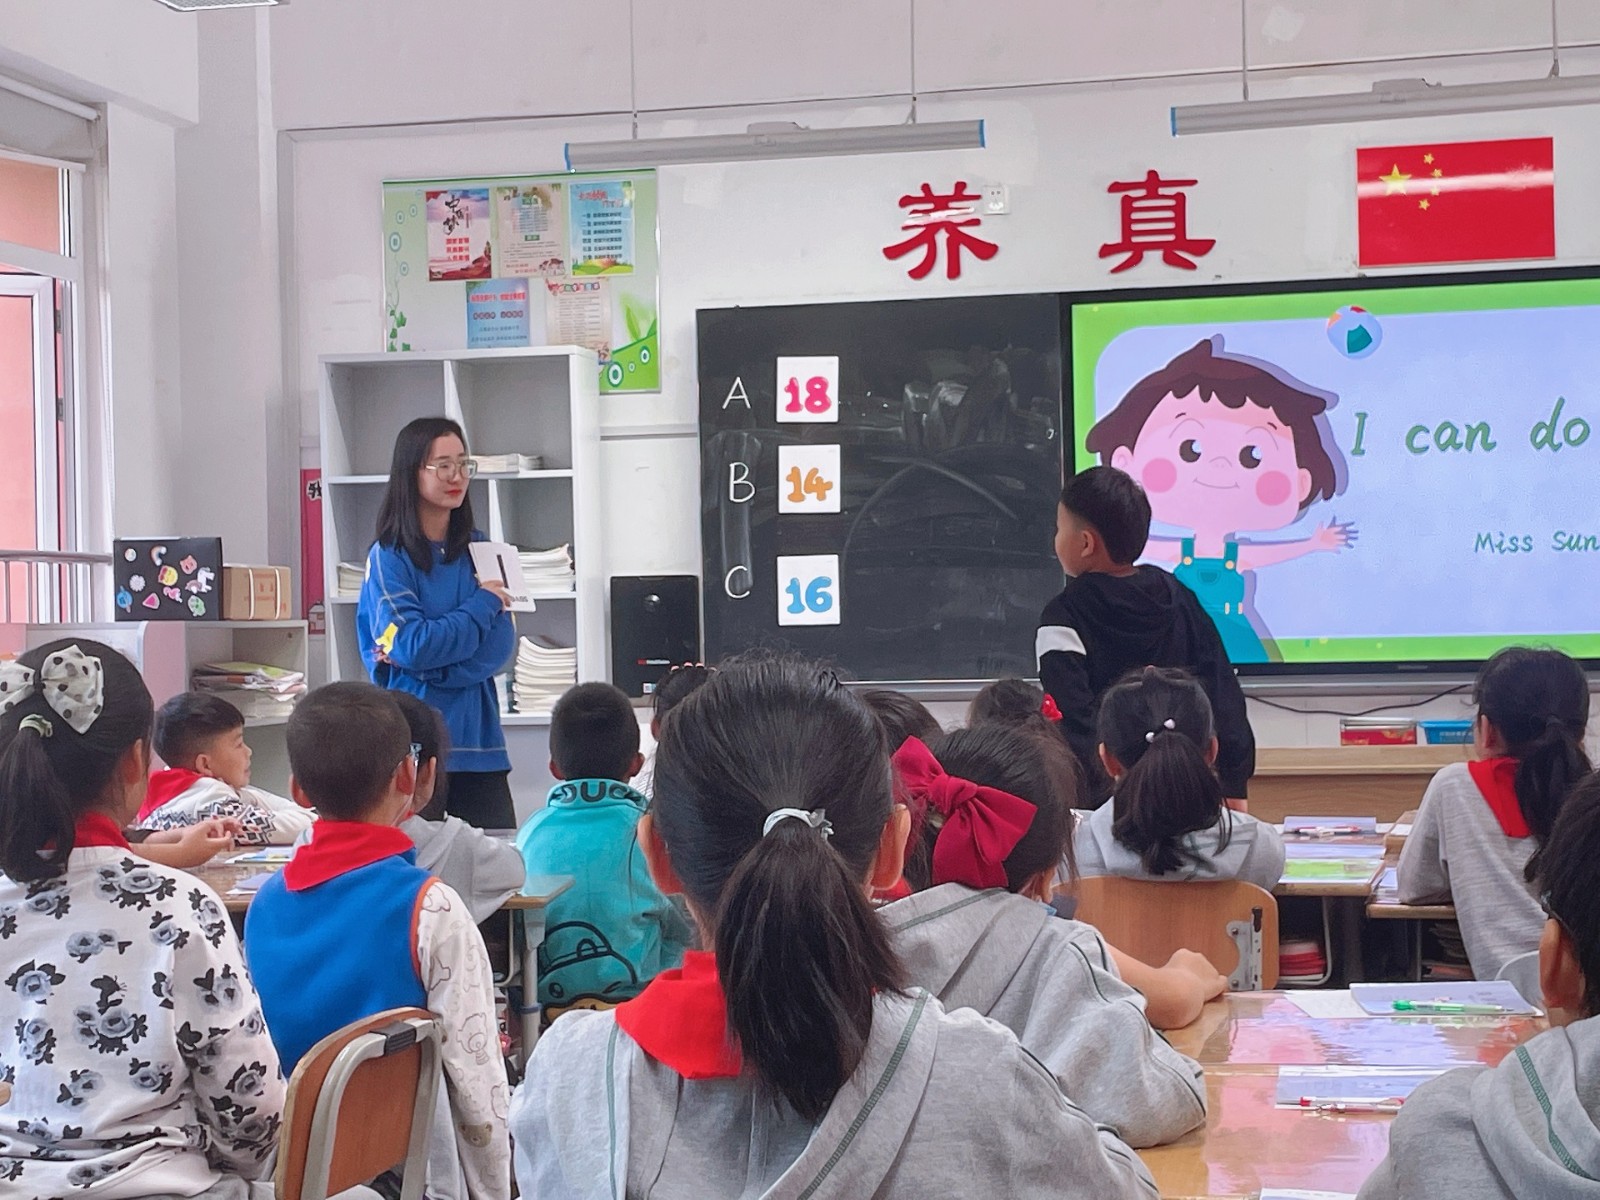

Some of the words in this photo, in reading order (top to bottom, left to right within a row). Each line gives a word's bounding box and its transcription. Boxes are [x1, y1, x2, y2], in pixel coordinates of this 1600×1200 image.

[722, 376, 751, 410] A
[785, 376, 832, 414] 18
[1351, 413, 1369, 456] I
[1405, 421, 1497, 455] can
[1529, 397, 1591, 452] do
[729, 462, 756, 503] B
[786, 466, 833, 503] 14
[1474, 531, 1533, 555] Miss
[1551, 530, 1600, 553] Sun
[724, 565, 750, 599] C
[785, 576, 833, 614] 16
